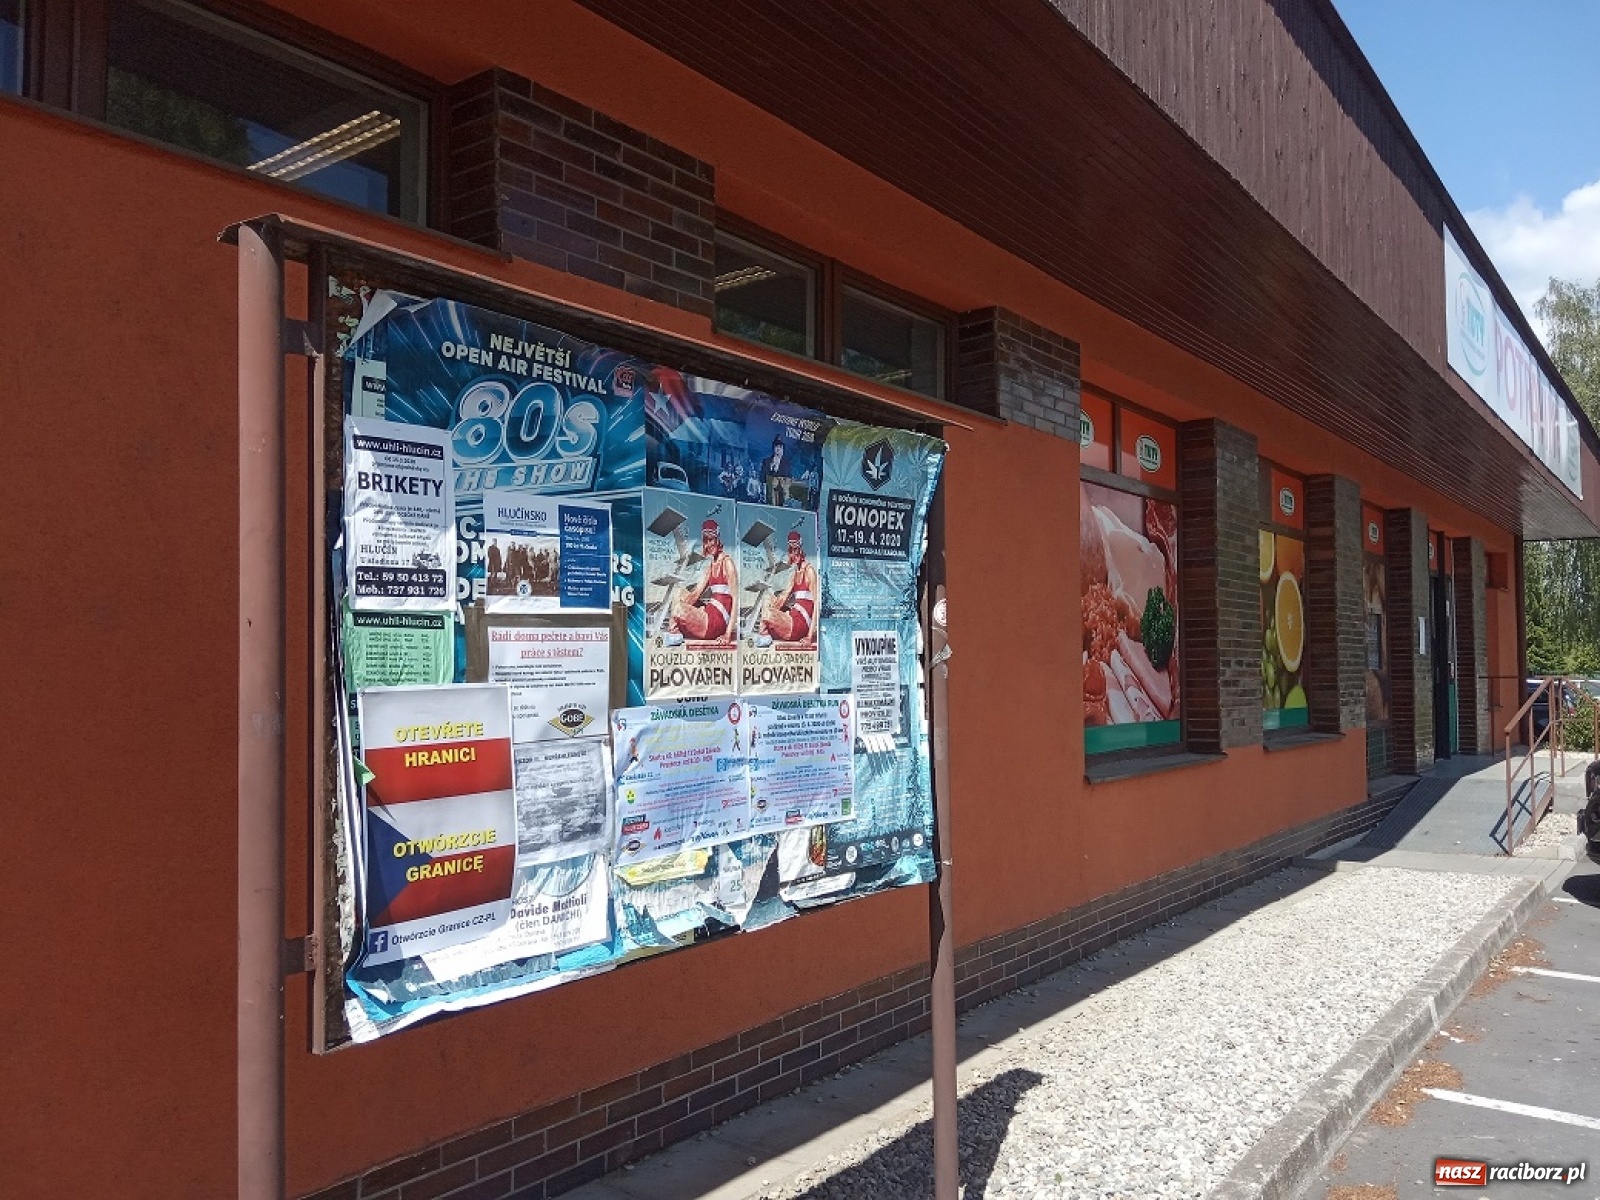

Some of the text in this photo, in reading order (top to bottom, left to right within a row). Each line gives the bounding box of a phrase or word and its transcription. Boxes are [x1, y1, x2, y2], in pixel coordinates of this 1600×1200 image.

[490, 333, 571, 368] NEJVĚTŠÍ
[441, 341, 493, 367] OPEN
[498, 356, 527, 377] AIR
[531, 364, 607, 395] FESTIVAL
[452, 381, 600, 466] 80s
[357, 471, 444, 497] BRIKETY
[512, 462, 589, 486] SHOW
[498, 507, 547, 522] HLUČÍNSKO
[834, 504, 906, 531] KONOPEX
[880, 533, 901, 547] 2020
[356, 571, 380, 581] Tel.:
[382, 572, 395, 582] 59
[411, 573, 430, 583] 413
[387, 585, 406, 595] 737
[407, 586, 426, 596] 931
[651, 653, 695, 667] KOUZLO
[742, 652, 782, 666] KOUZLO
[394, 721, 484, 743] OTEVŘETE
[405, 747, 477, 767] HRANICI
[393, 828, 497, 858] OTWÓRZCIE
[406, 855, 484, 882] GRANICĘ
[510, 902, 549, 919] Davide
[438, 919, 472, 935] Granice
[472, 911, 496, 926] CZ-PL
